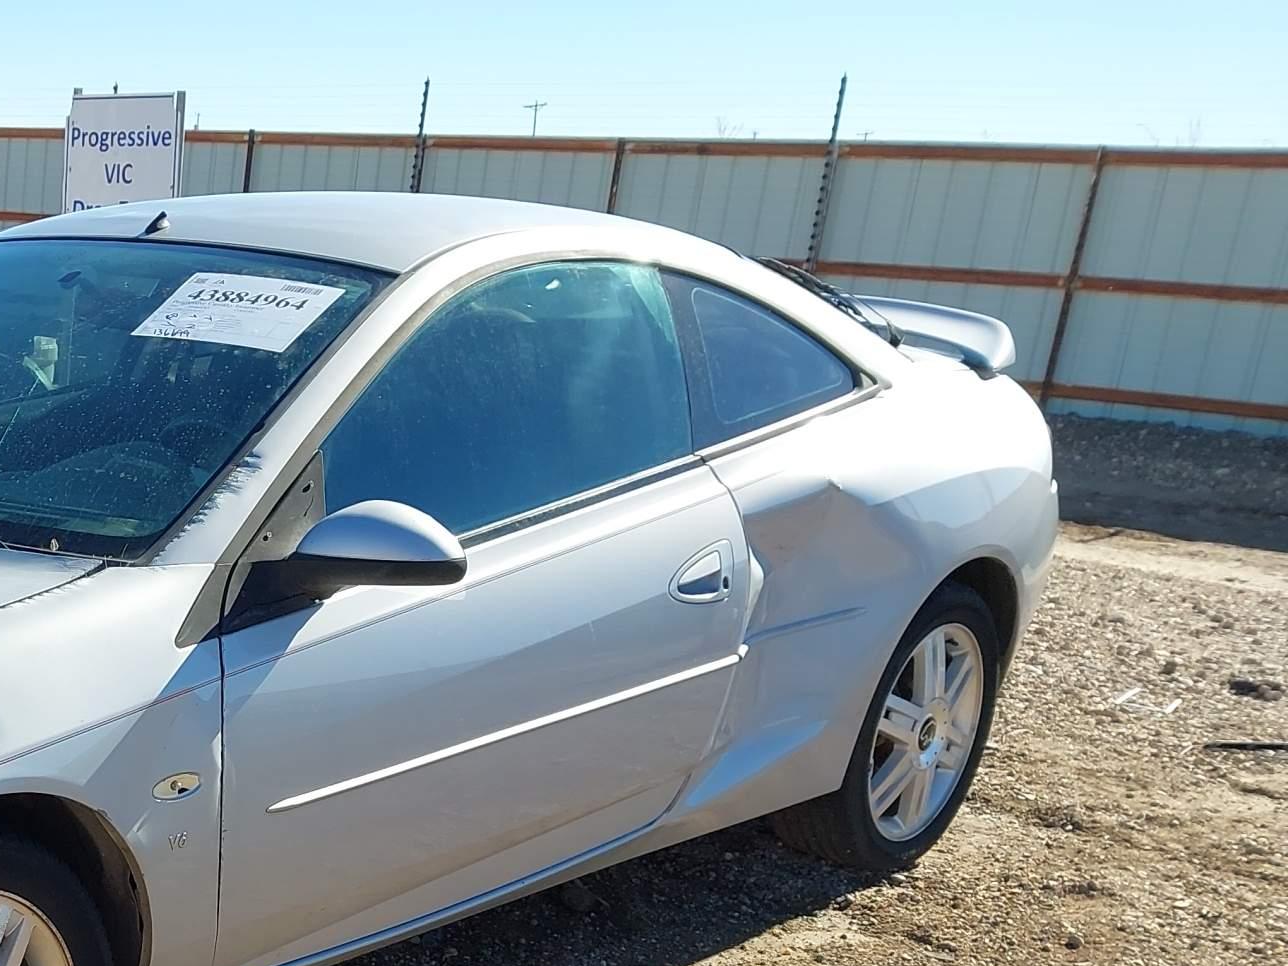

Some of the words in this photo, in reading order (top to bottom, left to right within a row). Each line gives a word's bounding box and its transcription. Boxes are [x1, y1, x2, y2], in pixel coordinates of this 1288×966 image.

[71, 124, 172, 152] Progressive
[104, 163, 134, 185] VIC
[187, 288, 311, 311] 43884964
[168, 831, 187, 852] V6
